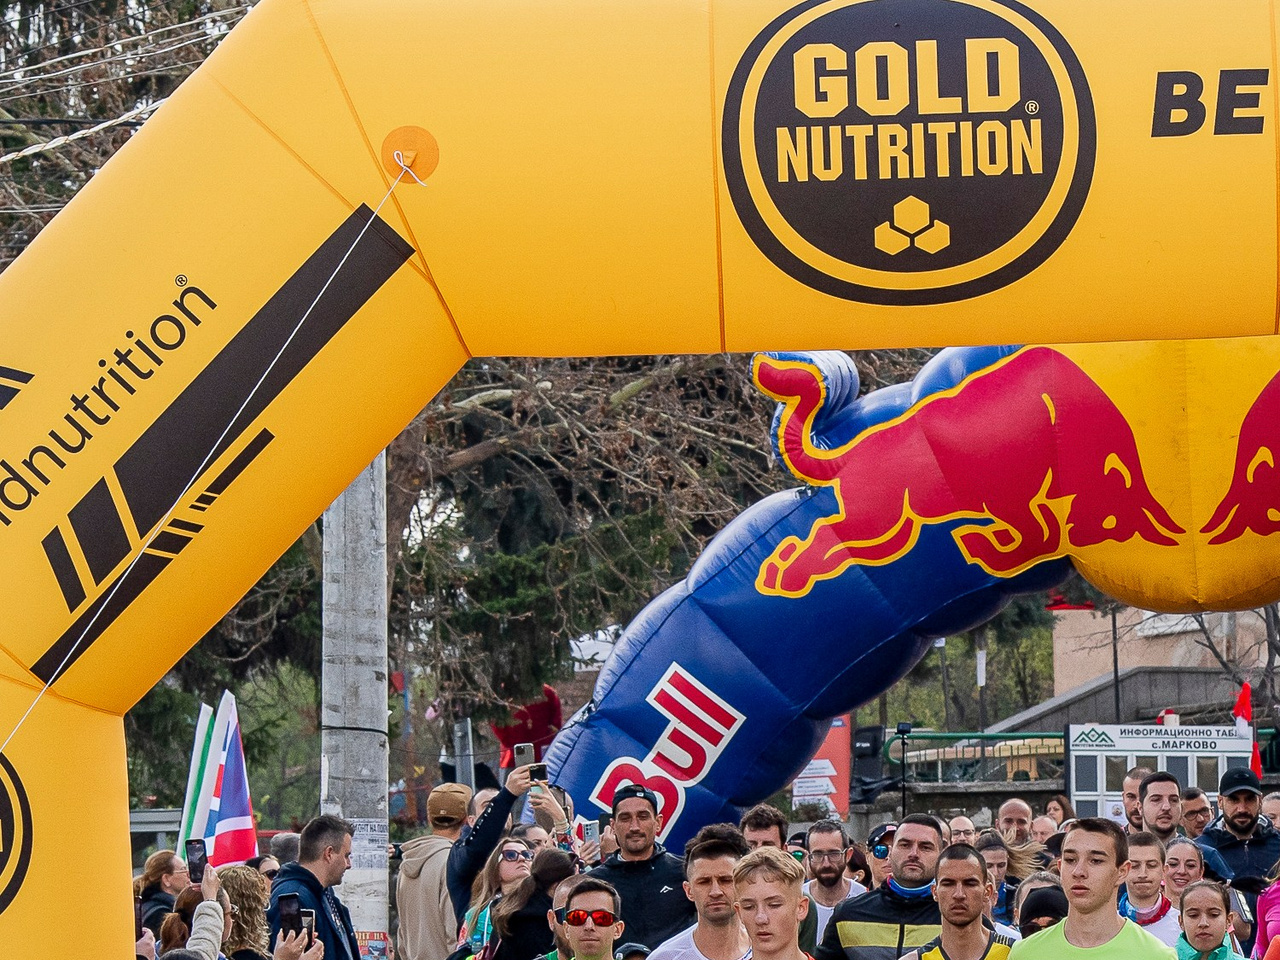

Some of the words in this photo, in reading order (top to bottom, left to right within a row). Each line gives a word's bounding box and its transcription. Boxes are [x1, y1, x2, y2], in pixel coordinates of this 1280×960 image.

[793, 37, 1021, 118] GOLD
[1150, 69, 1269, 138] BE
[776, 118, 1043, 182] NUTRITION
[589, 662, 746, 844] Bull
[1120, 728, 1212, 738] ИНФОРМАЦИОННО
[1151, 740, 1217, 749] с.МАРКОВО
